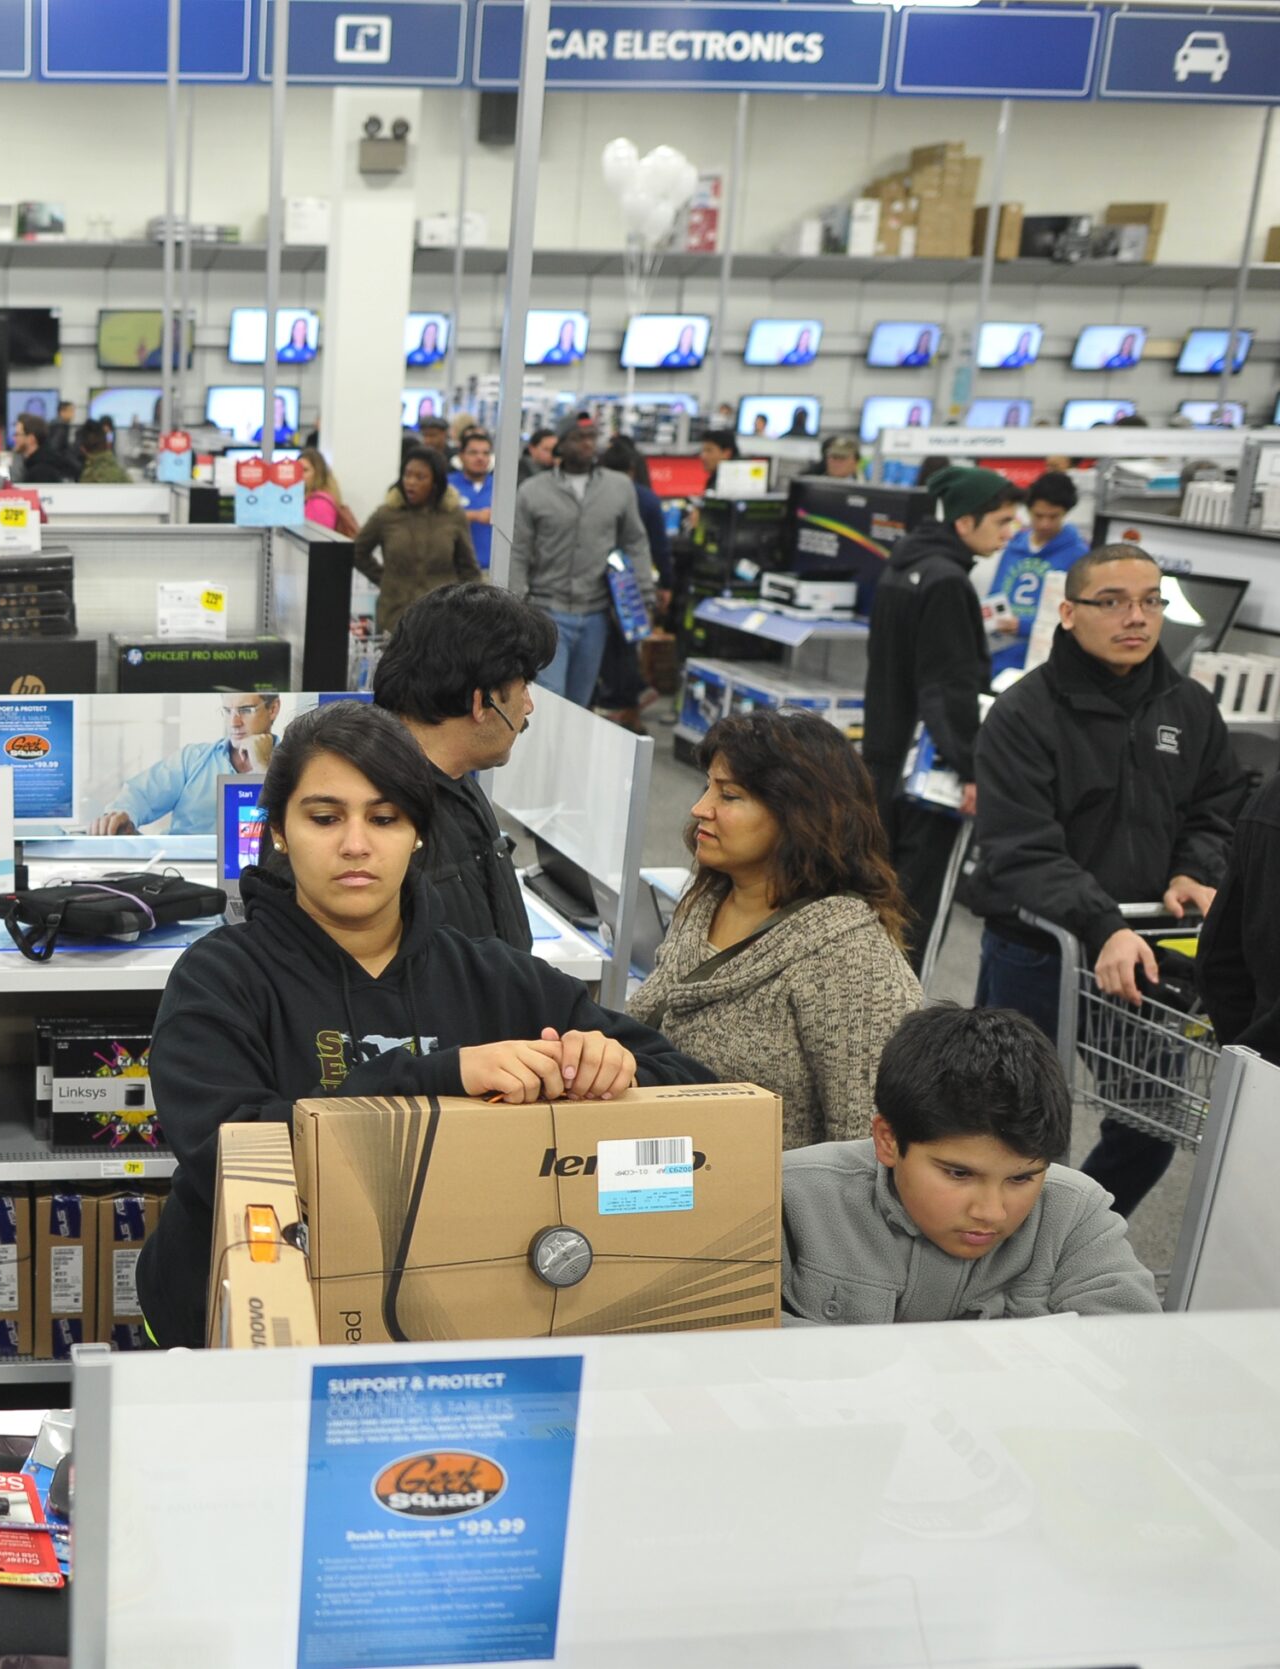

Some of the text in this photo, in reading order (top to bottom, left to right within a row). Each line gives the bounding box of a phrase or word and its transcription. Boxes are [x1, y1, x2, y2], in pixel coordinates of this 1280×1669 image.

[546, 29, 824, 63] CAR ELECTRONICS
[1014, 572, 1040, 605] 2
[143, 651, 190, 661] OFFICEJET
[191, 651, 211, 661] PRO
[238, 651, 259, 660] PLUS
[238, 790, 253, 798] Start
[58, 1086, 107, 1100] Linksys
[249, 1296, 266, 1348] novo
[339, 1310, 362, 1342] ad
[327, 1372, 507, 1394] SUPPORT & PROTECT
[394, 1454, 486, 1494] Geek
[388, 1490, 486, 1510] Squad
[458, 1517, 526, 1537] $99.99
[5, 1554, 41, 1566] Cruzer
